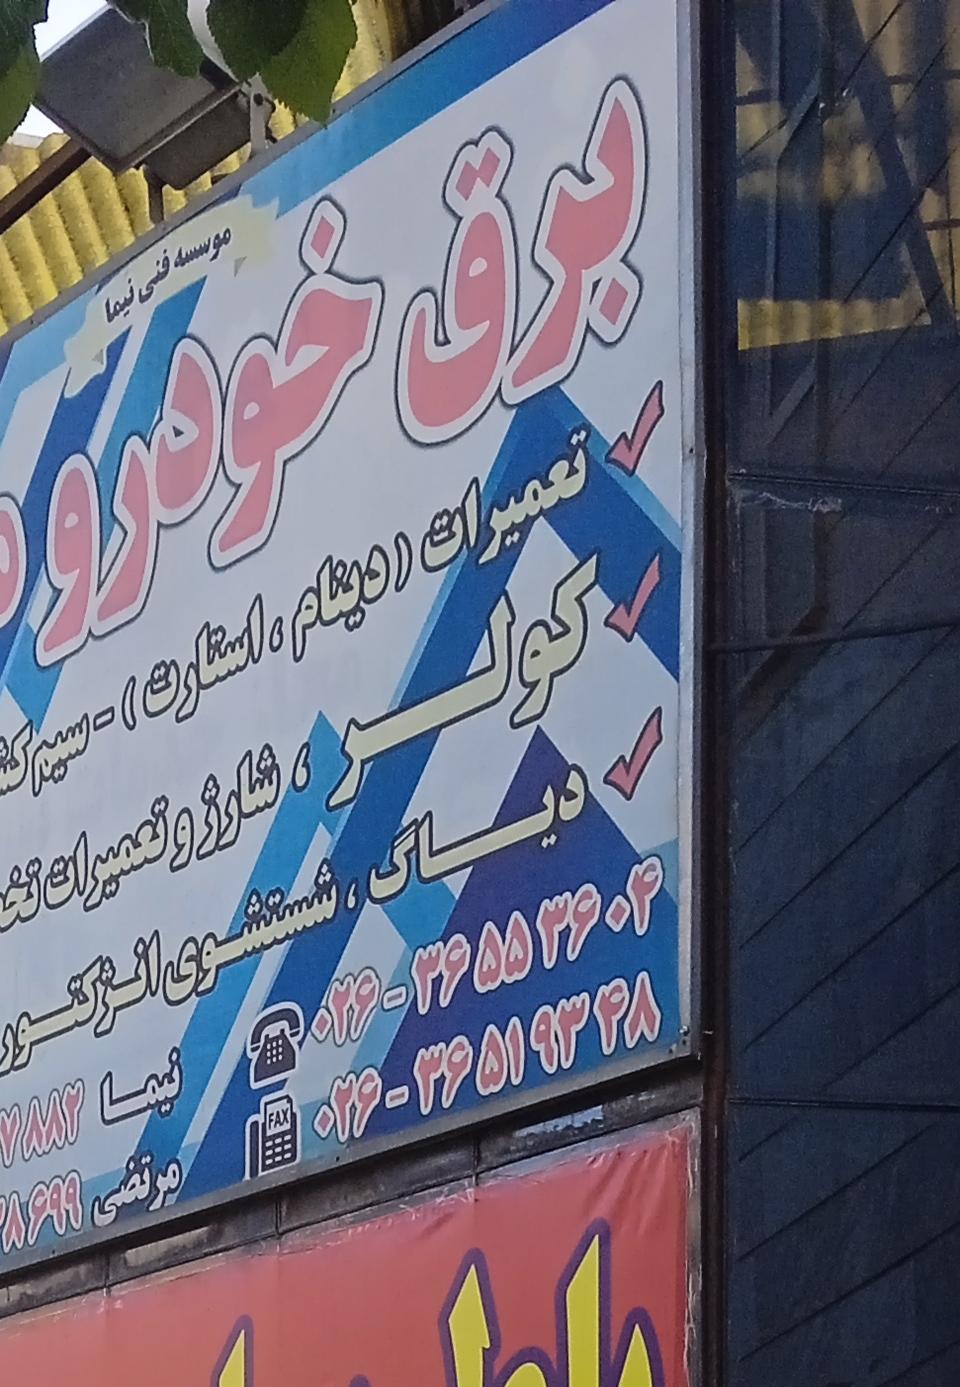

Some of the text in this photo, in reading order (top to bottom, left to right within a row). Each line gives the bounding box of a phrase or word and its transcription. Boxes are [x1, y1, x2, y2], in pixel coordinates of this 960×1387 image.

[104, 228, 231, 323] موسسه فنی نیما
[398, 76, 648, 445] برق
[35, 198, 384, 666] خودرو
[421, 423, 591, 572] تعمیرات
[326, 547, 599, 811] کولر
[43, 795, 170, 911] تعمیرات
[170, 806, 196, 873] و
[196, 743, 281, 861] شارژ
[368, 763, 589, 908] دیاگ
[162, 858, 339, 1007] شستشوی
[100, 1047, 183, 1125] نیما
[267, 1105, 290, 1129] FAX
[90, 1154, 183, 1228] مرتضی
